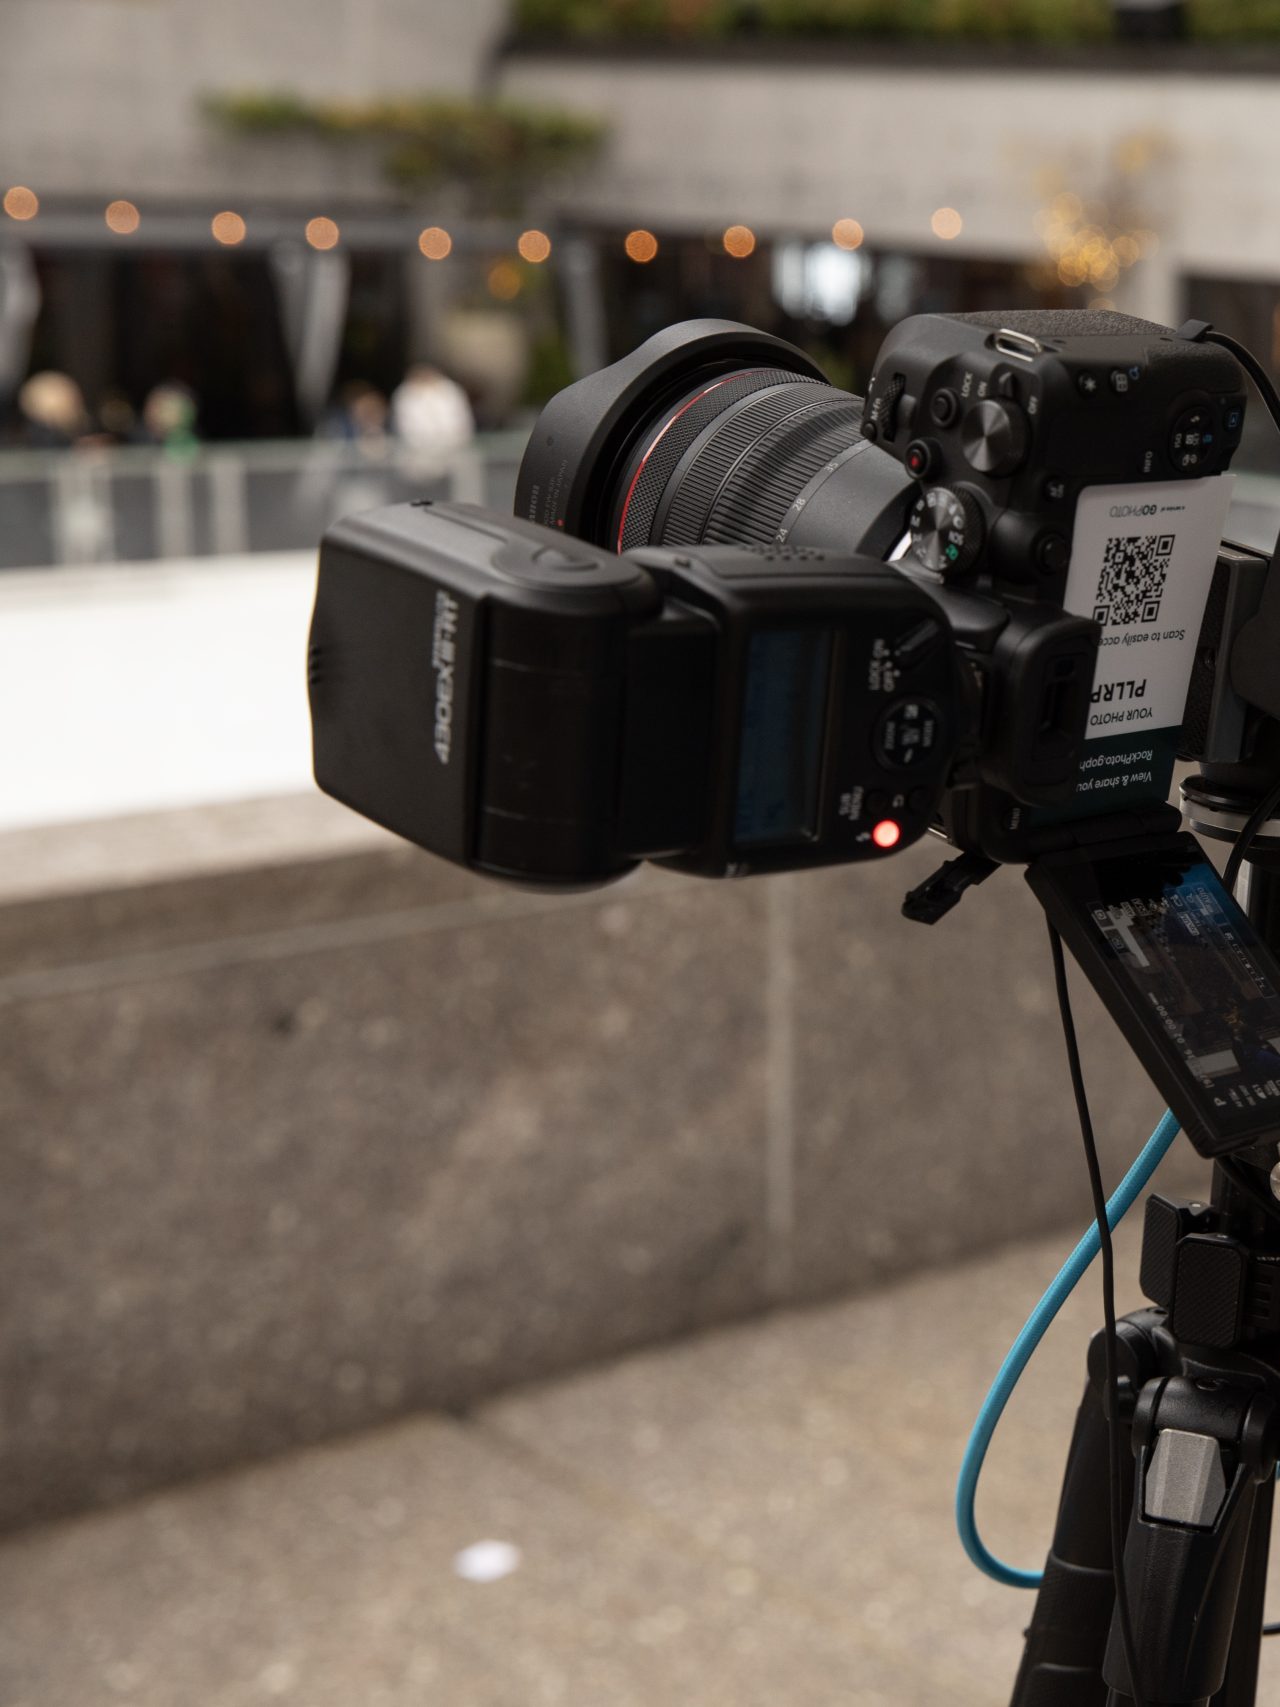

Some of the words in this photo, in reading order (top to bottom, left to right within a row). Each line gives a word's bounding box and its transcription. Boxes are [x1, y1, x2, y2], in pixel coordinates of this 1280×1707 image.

[961, 372, 973, 398] LOCK
[977, 381, 987, 397] ON
[1027, 395, 1038, 415] OFF
[1174, 433, 1182, 448] ISO
[824, 461, 839, 473] 35
[792, 498, 806, 512] 28
[1109, 504, 1157, 518] GOPHOTO
[775, 528, 788, 543] 24
[1122, 632, 1149, 646] easily
[1151, 632, 1161, 643] to
[1163, 629, 1185, 641] Scan
[869, 659, 879, 691] LOCK
[1090, 679, 1147, 703] PLLRP
[1090, 711, 1125, 726] PHOTO
[1127, 707, 1153, 720] YOUR
[1094, 776, 1120, 789] share
[1121, 775, 1130, 786] &
[1130, 771, 1152, 783] View
[1214, 1096, 1227, 1107] P
